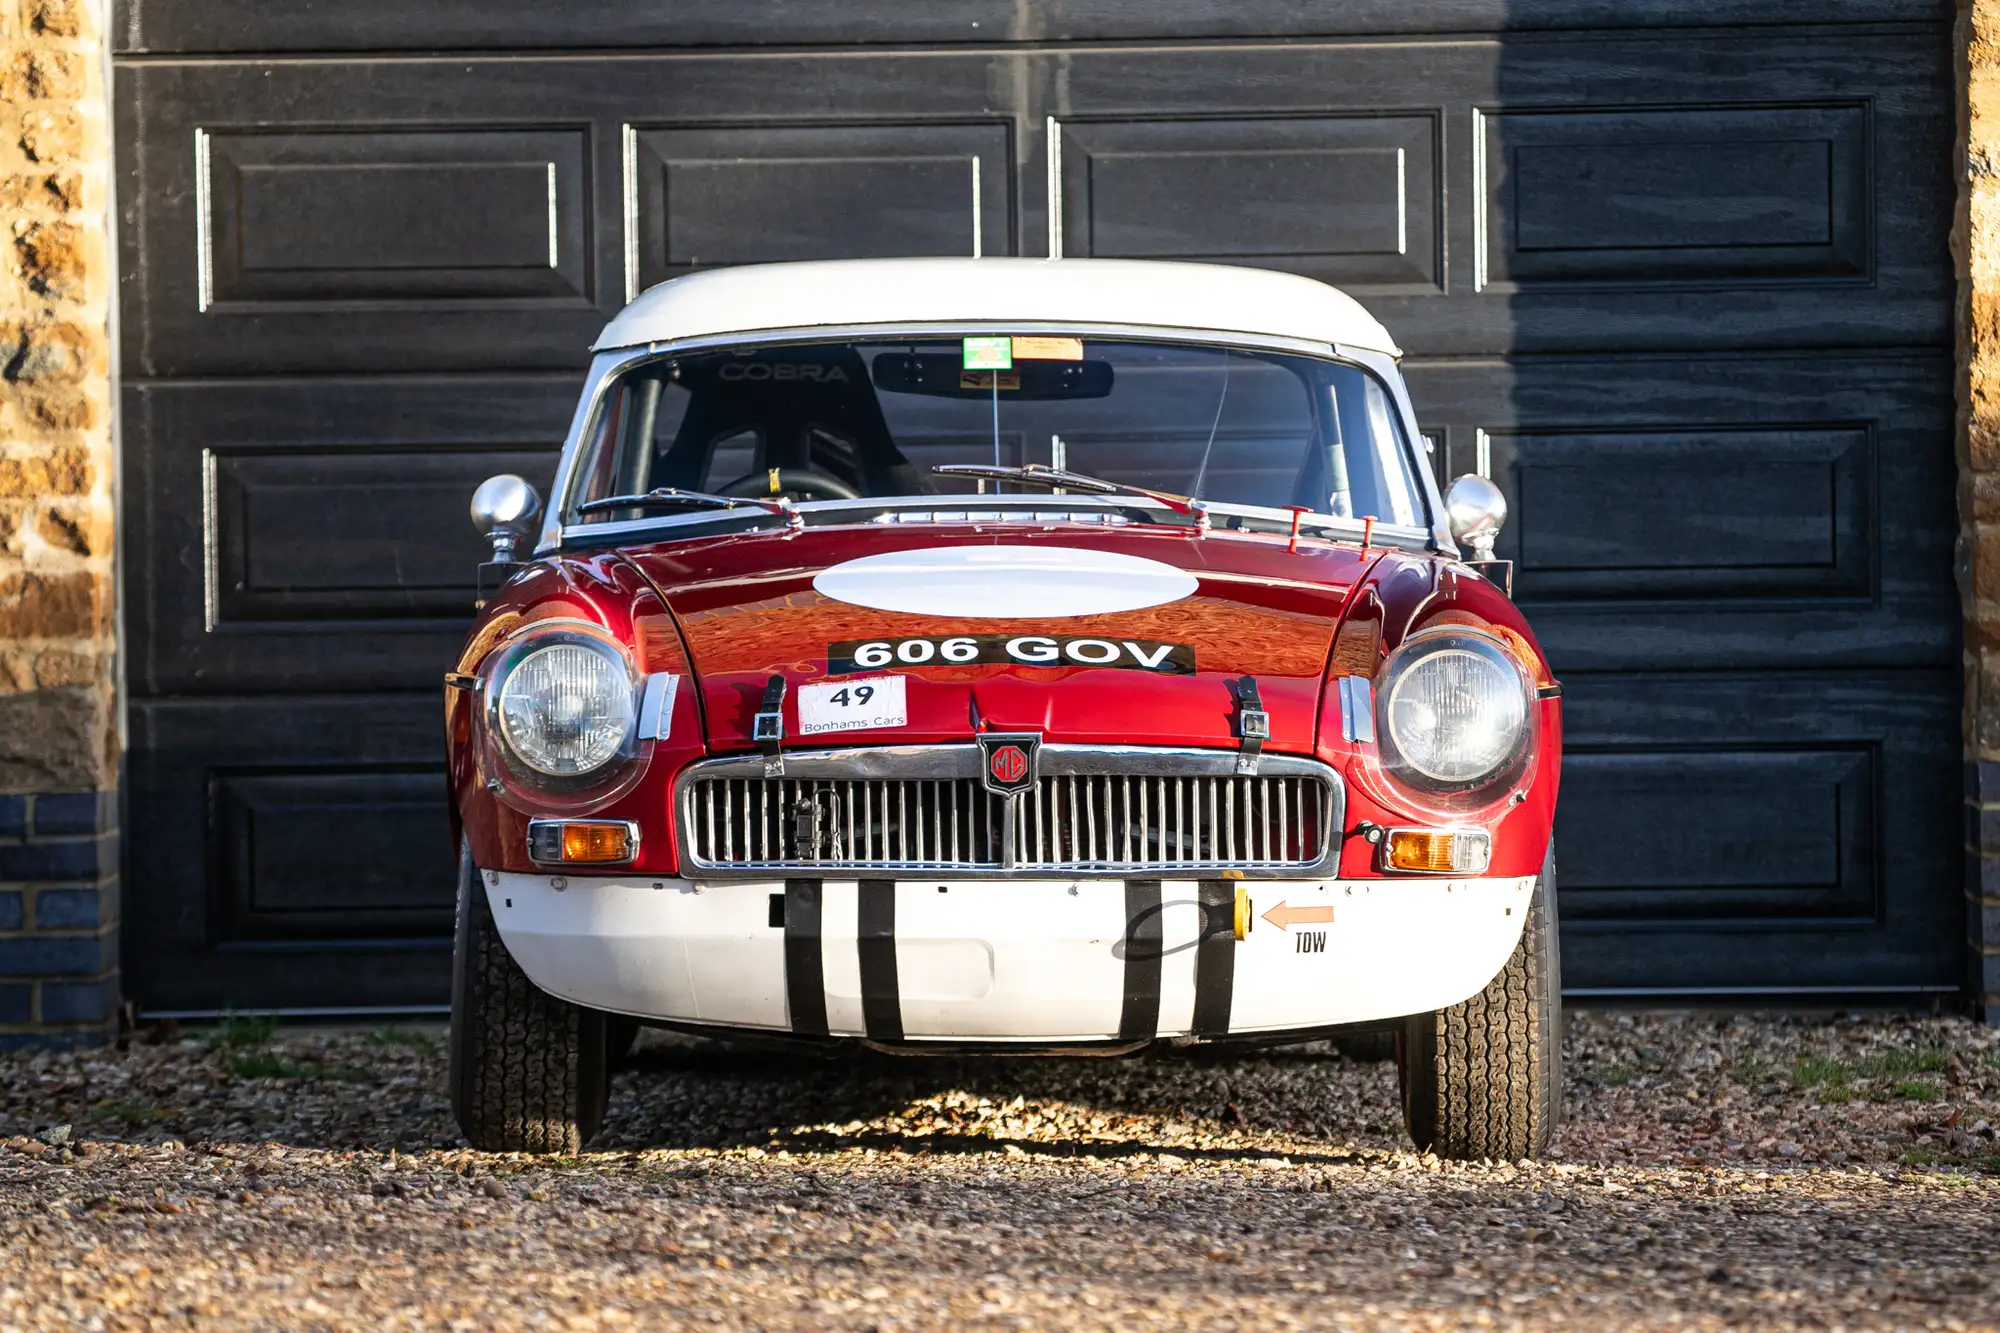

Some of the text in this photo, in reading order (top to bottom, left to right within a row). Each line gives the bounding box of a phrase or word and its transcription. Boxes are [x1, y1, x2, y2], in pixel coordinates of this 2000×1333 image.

[718, 362, 849, 383] COBRA
[853, 636, 1175, 668] 606 GOV
[829, 685, 875, 707] 49
[804, 716, 904, 733] Bonhams Cars
[994, 749, 1024, 779] MG
[1295, 931, 1327, 954] TOW
